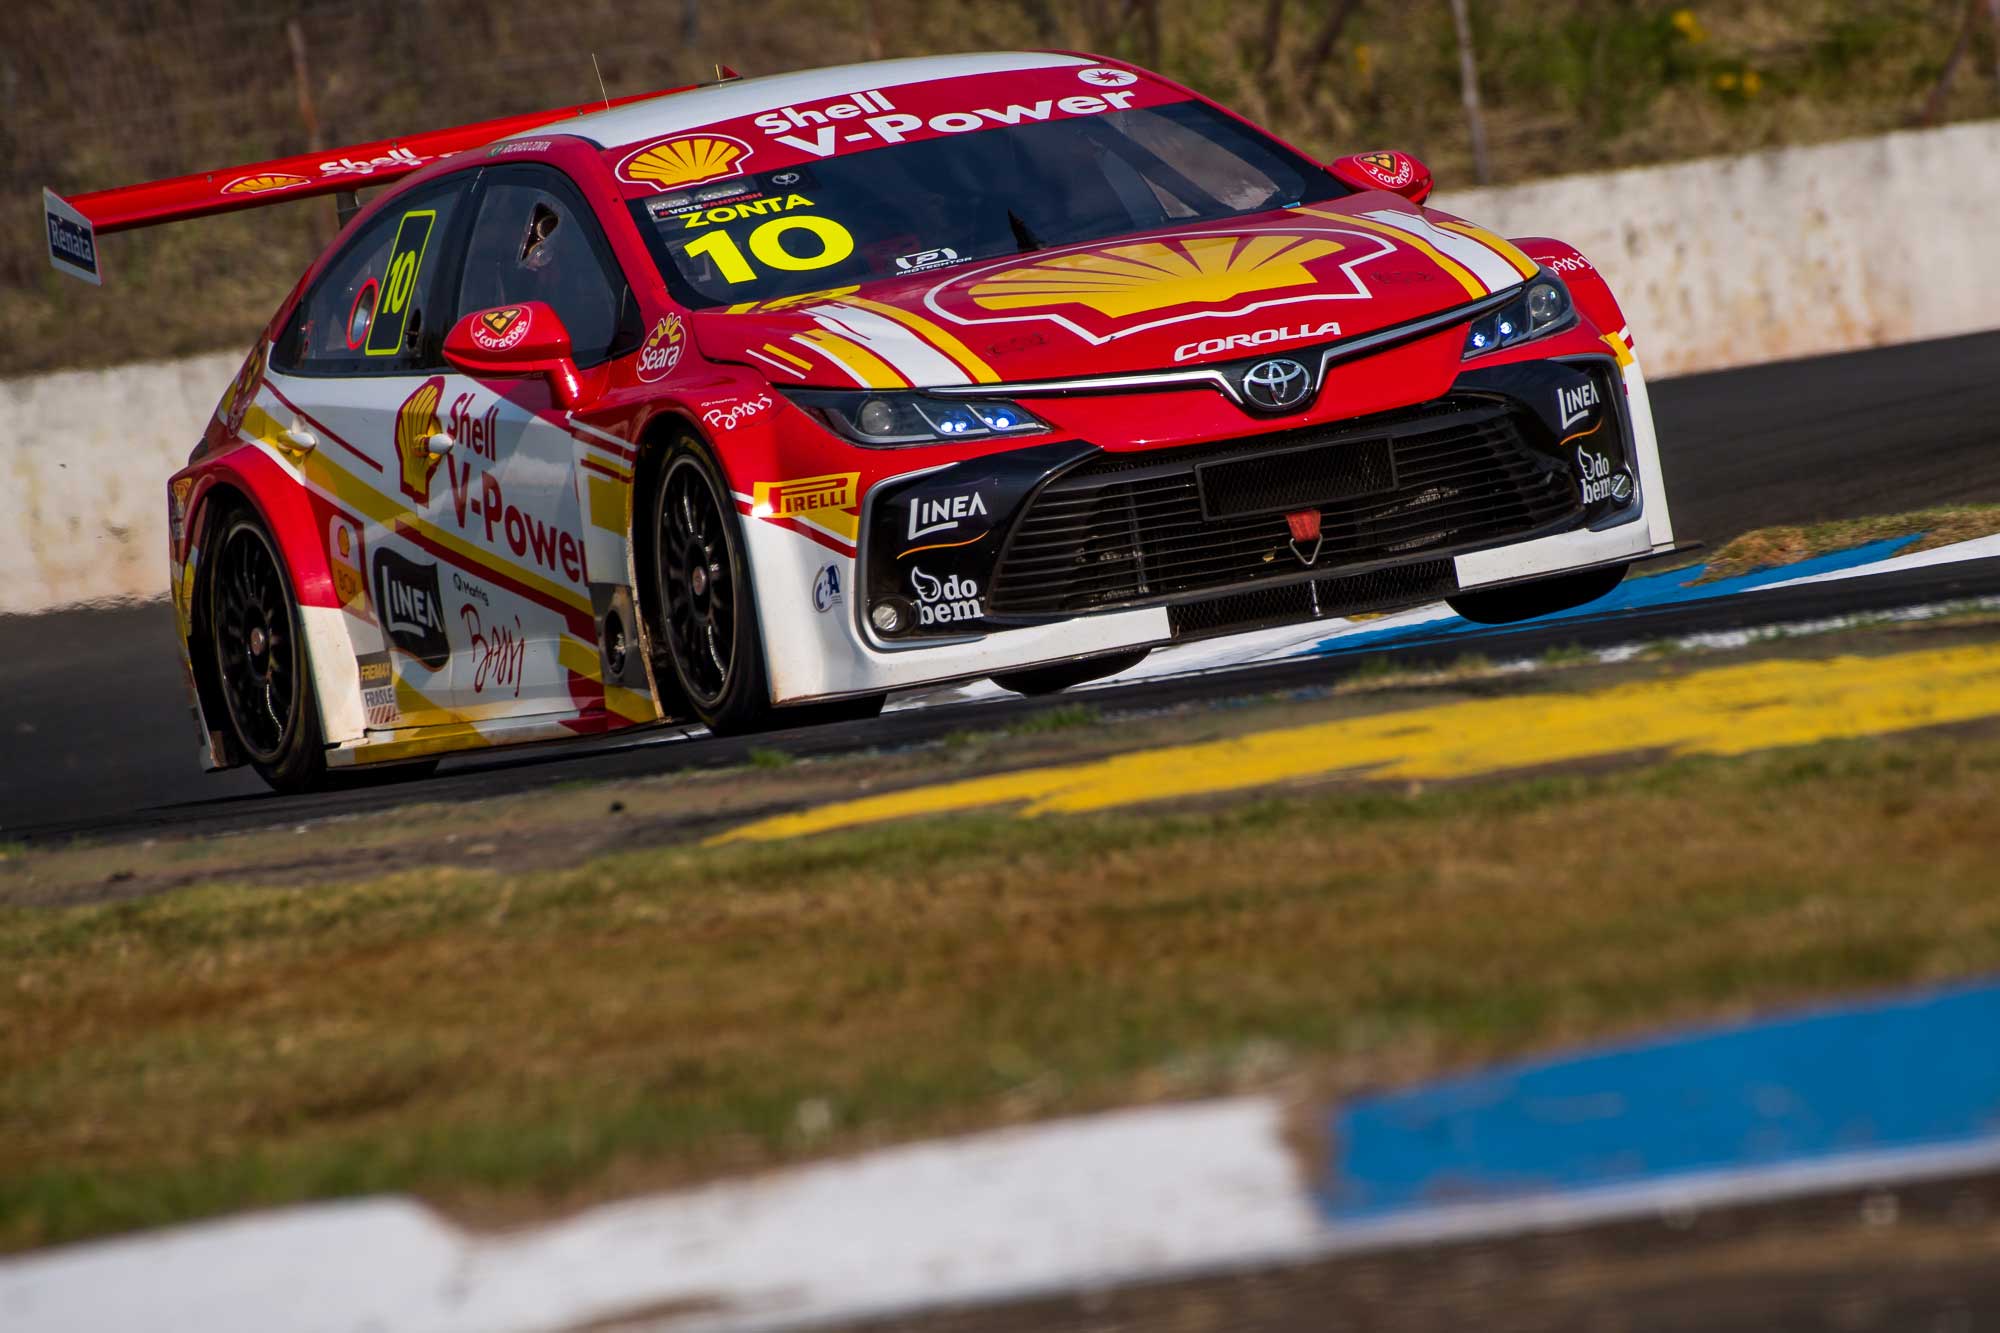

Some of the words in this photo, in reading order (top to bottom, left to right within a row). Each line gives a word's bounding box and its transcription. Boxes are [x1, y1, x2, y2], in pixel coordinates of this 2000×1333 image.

[754, 90, 896, 135] Shell
[774, 90, 1135, 157] V-Power
[1369, 167, 1379, 175] 3
[1378, 161, 1410, 184] corações
[679, 193, 815, 228] ZONTA
[50, 219, 93, 262] Renata
[684, 215, 854, 284] 10
[382, 250, 416, 314] 10
[474, 328, 483, 338] 3
[480, 320, 527, 348] corações
[1174, 321, 1341, 362] COROLLA
[638, 345, 680, 371] Seara
[1557, 380, 1600, 430] LINEA
[447, 392, 499, 462] Shell
[1595, 452, 1610, 478] do
[768, 477, 849, 514] PIRELLI
[1581, 477, 1611, 504] bem
[908, 491, 987, 540] LINEA
[382, 565, 442, 638] LINEA
[944, 575, 978, 599] do
[919, 598, 984, 625] bem
